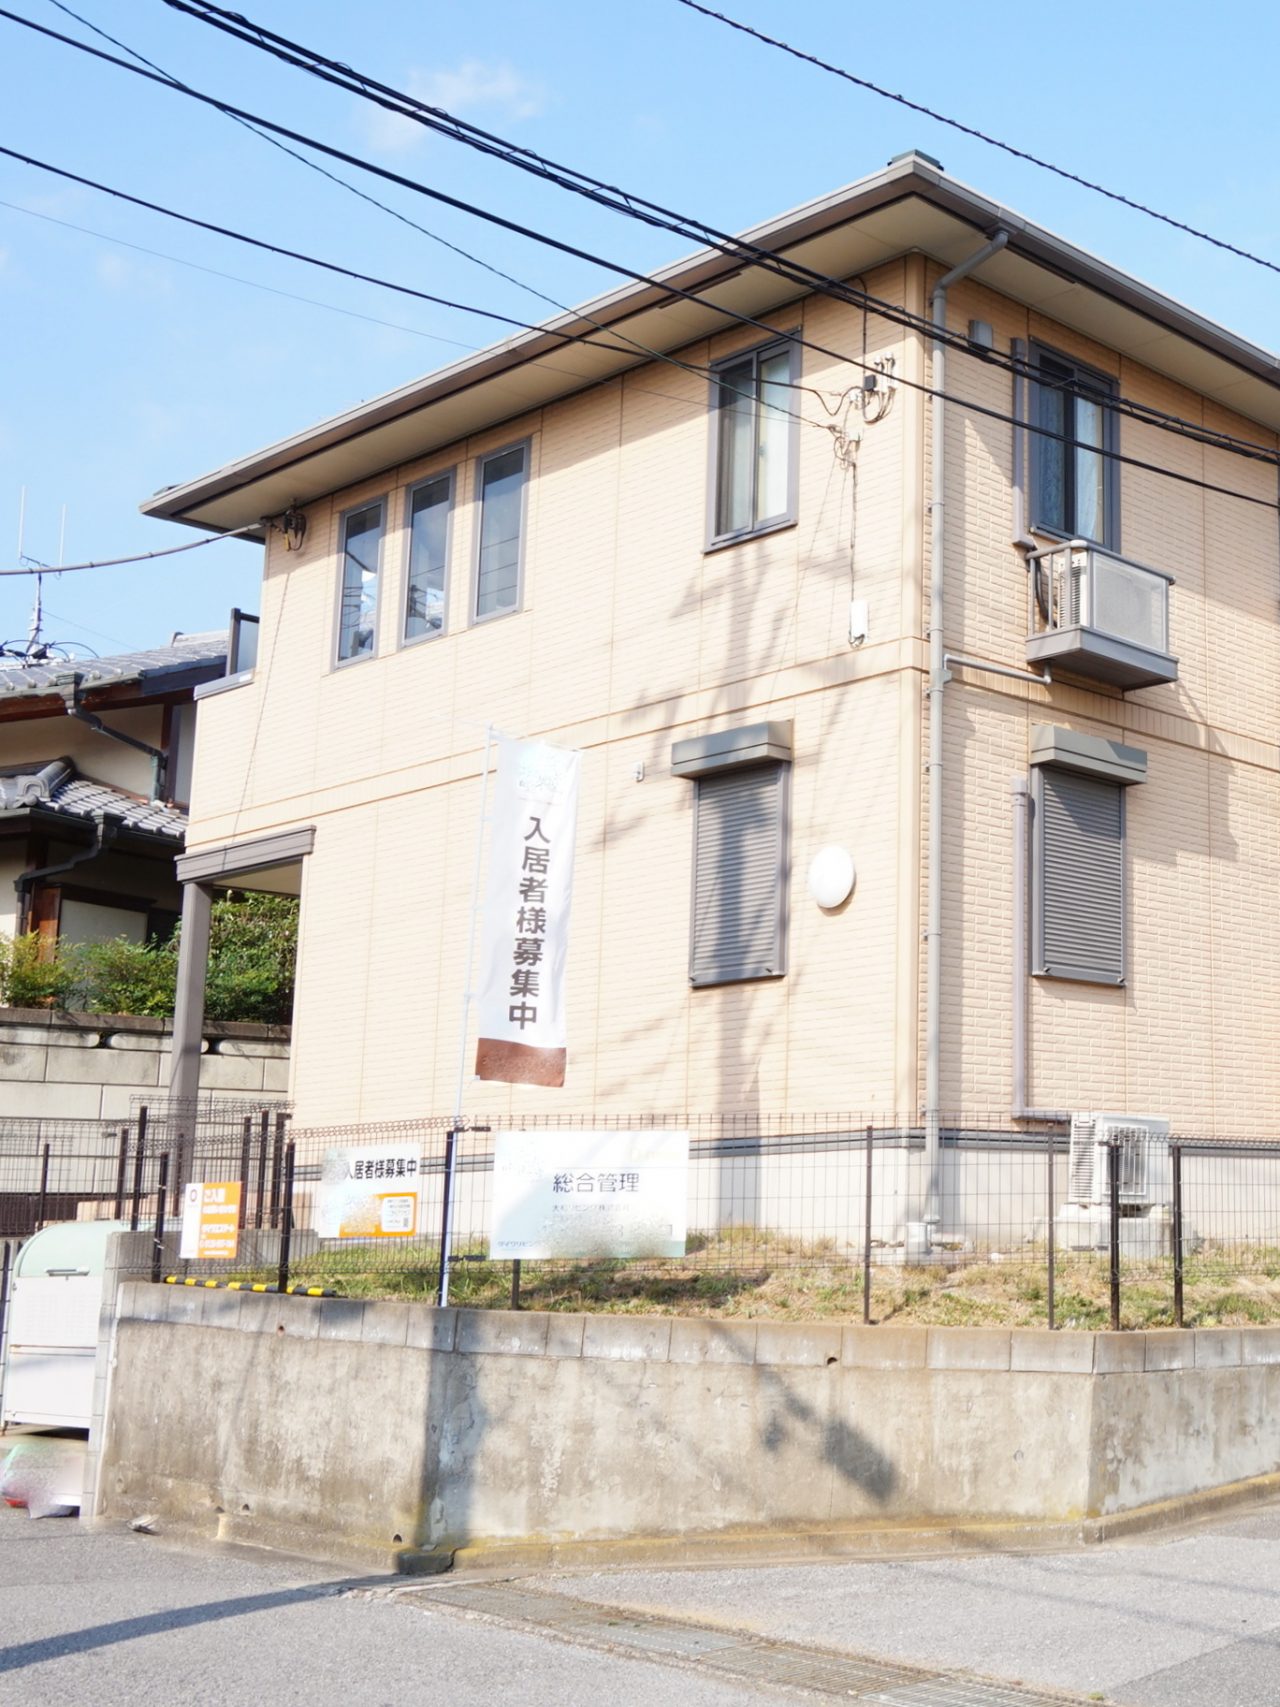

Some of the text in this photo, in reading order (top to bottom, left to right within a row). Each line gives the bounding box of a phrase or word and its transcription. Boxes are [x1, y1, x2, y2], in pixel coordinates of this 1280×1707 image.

[508, 816, 551, 1031] 入居者様募集中
[344, 1157, 417, 1180] 入居者様募集中
[552, 1172, 640, 1193] 総合管理
